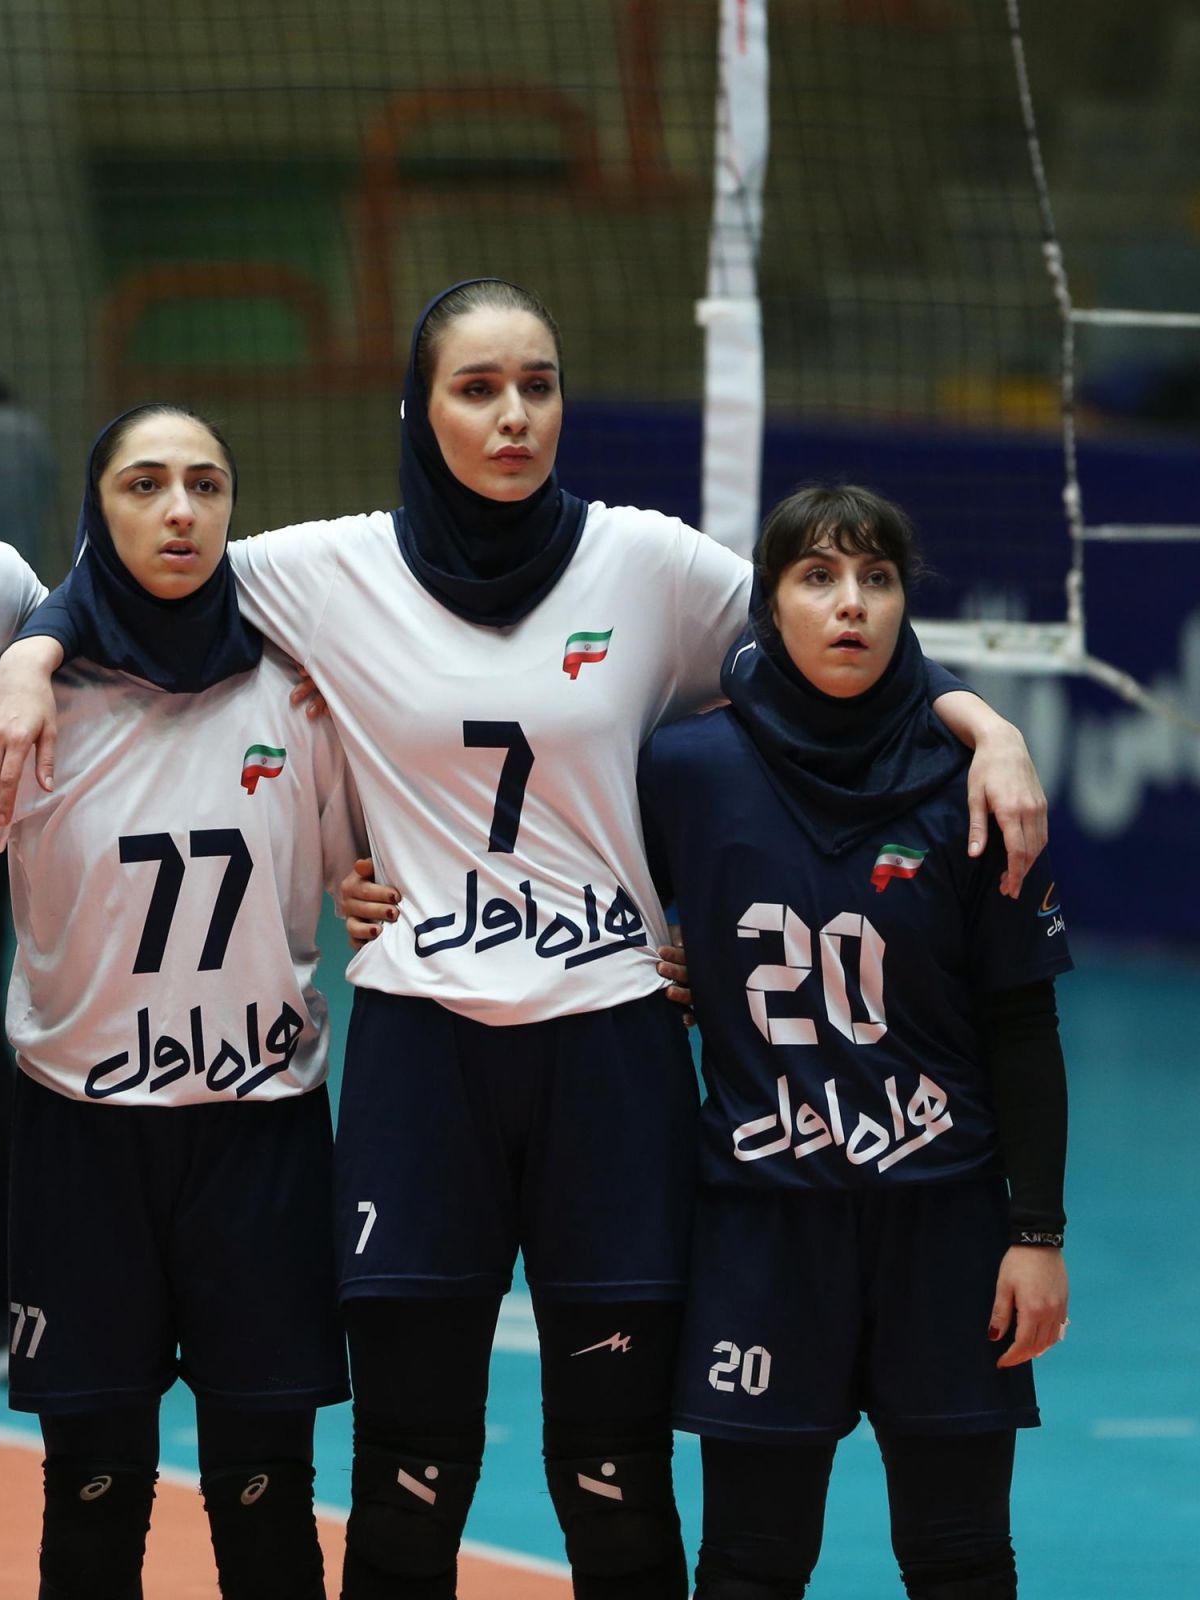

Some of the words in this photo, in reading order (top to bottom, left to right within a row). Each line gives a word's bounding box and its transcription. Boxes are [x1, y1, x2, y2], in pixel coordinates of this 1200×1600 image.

[463, 720, 535, 853] 7
[118, 828, 254, 974] 77
[414, 869, 537, 958] اول
[737, 902, 888, 1045] 20
[85, 1005, 205, 1099] اول
[732, 1074, 845, 1162] اول
[356, 1201, 377, 1254] 7
[10, 1302, 47, 1358] 77
[708, 1340, 771, 1395] 20
